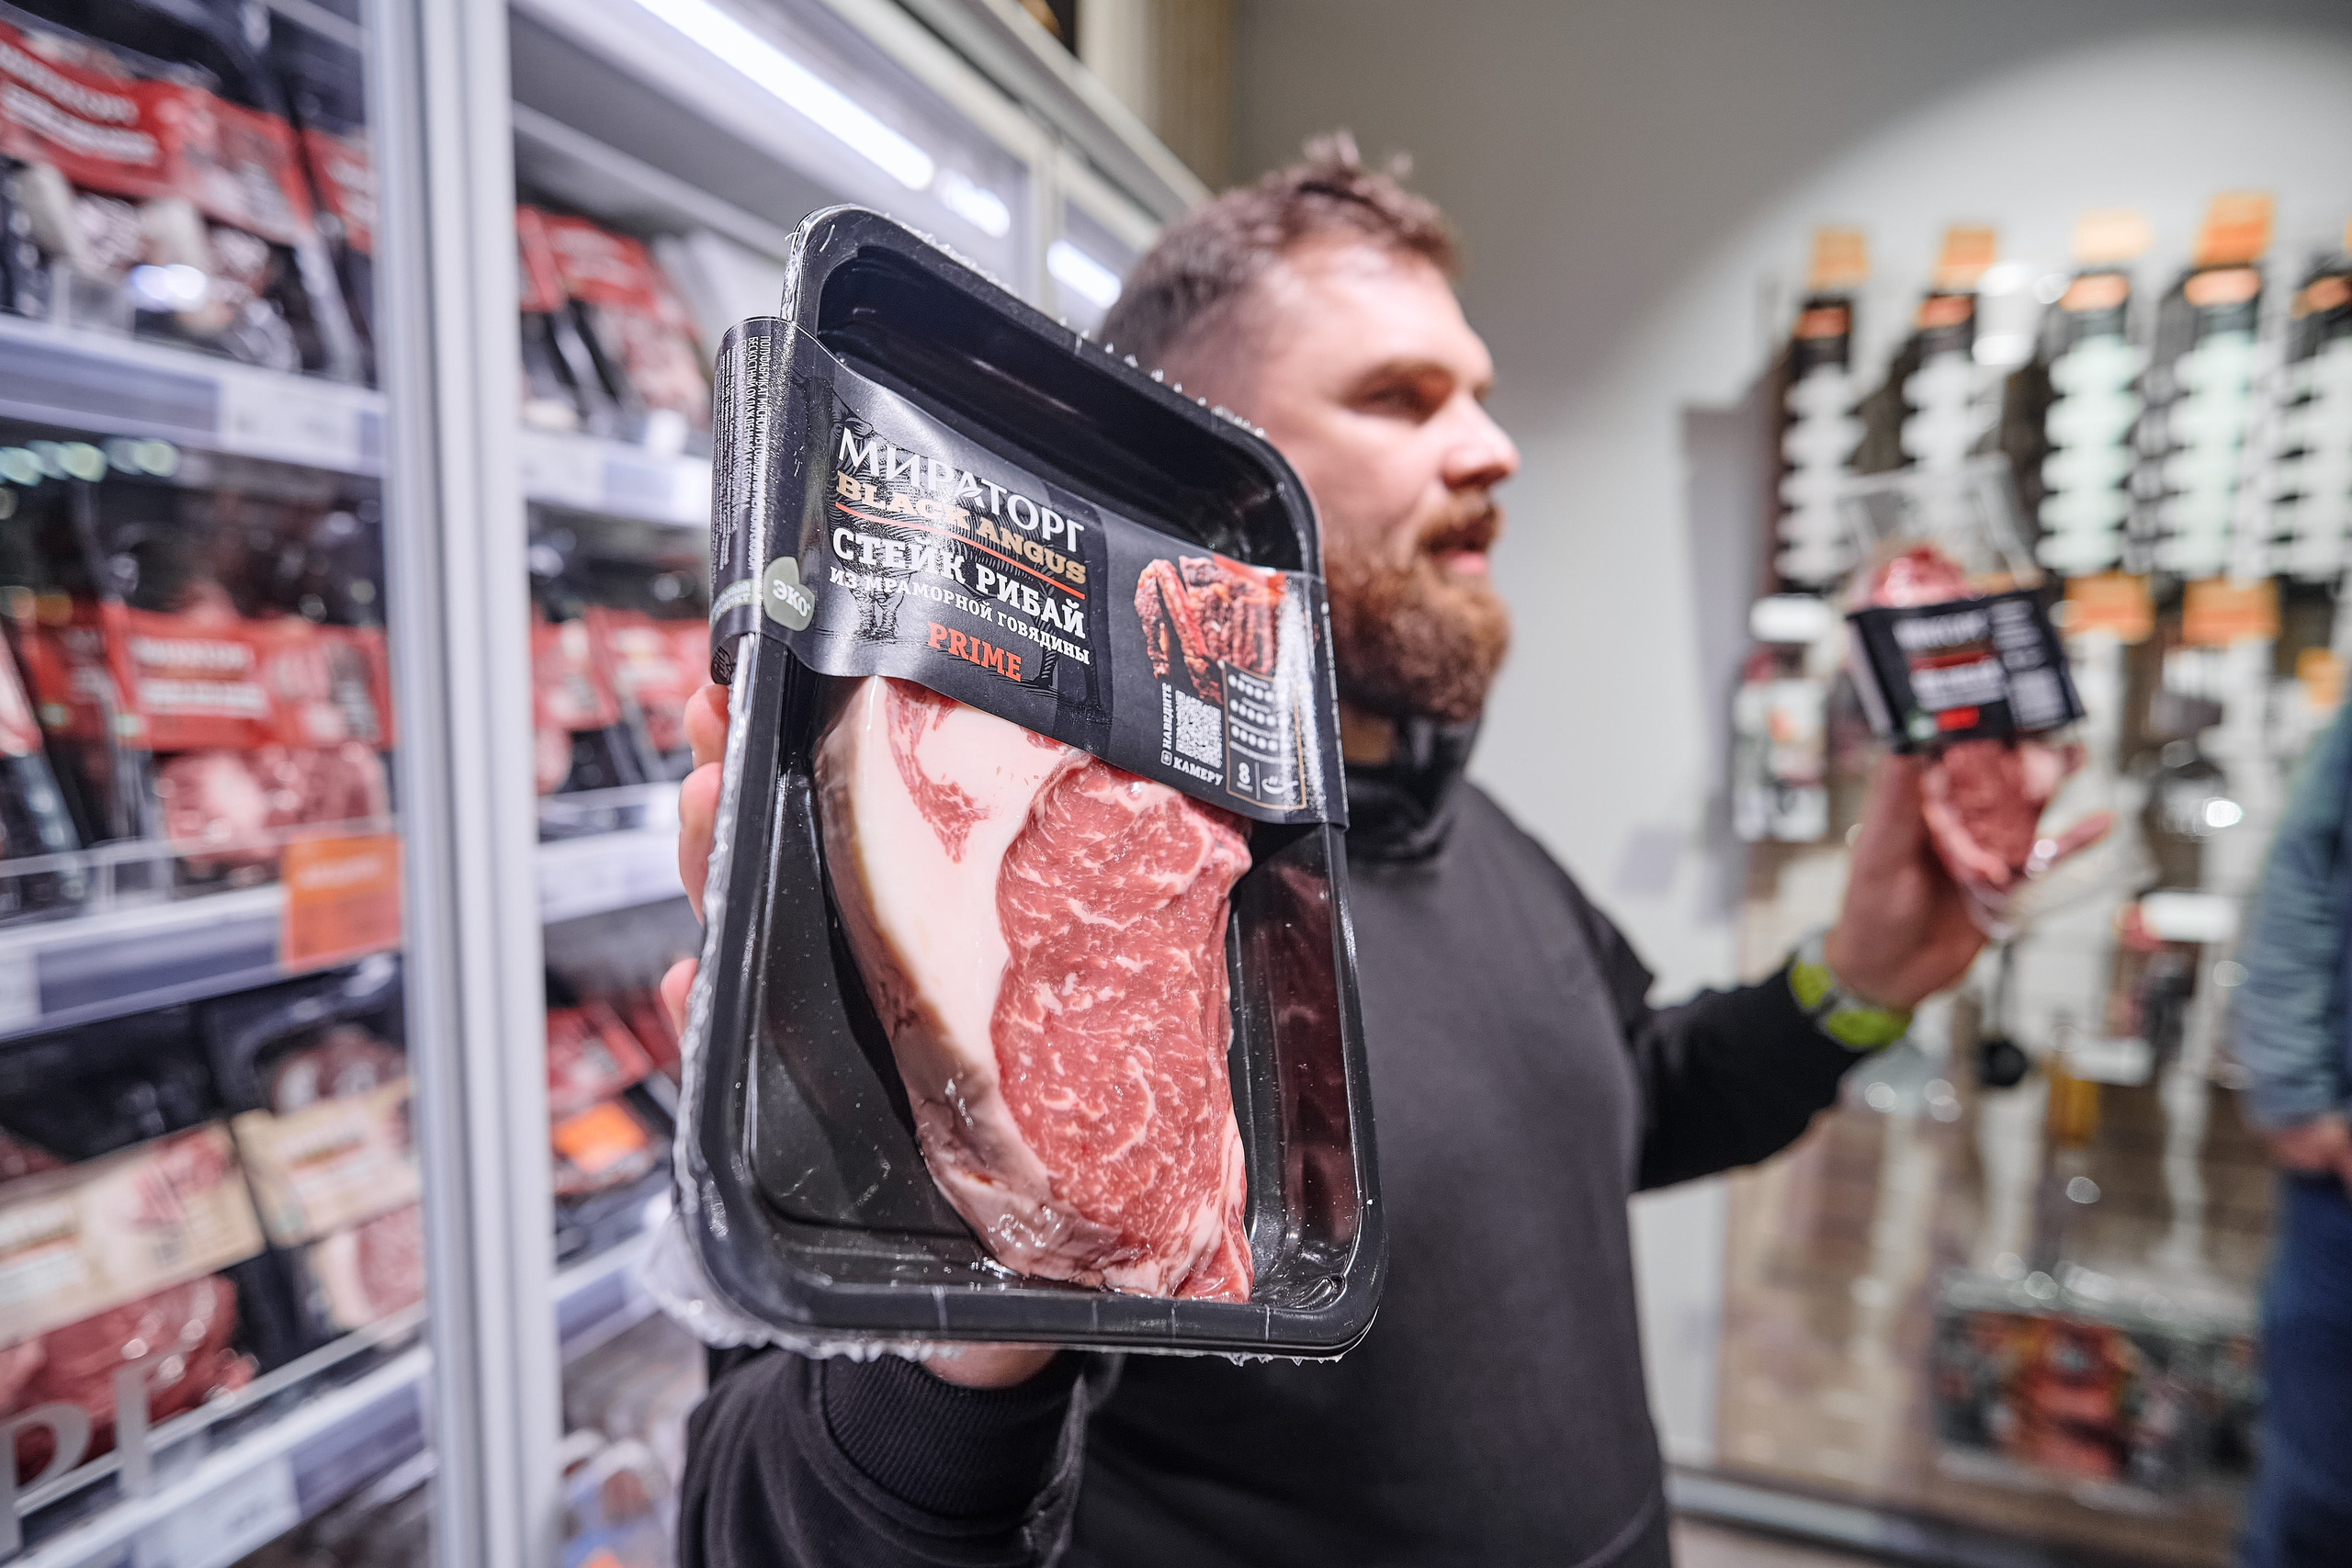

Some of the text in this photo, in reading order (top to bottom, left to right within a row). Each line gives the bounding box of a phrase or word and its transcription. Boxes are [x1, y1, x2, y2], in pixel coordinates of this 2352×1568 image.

[746, 336, 759, 389] БЕСКОСТНЫЙ
[757, 335, 771, 396] ПОЛУФАБРИКАТ
[839, 427, 1085, 552] МИРАТОРГ
[836, 470, 1087, 585] BLACK ANGUS
[832, 527, 1086, 639] СТЕЙК РИБАЙ
[829, 566, 1091, 666] ИЗ МРАМОРНОЙ ГОВЯДИНЫ
[927, 621, 1023, 682] PRIME
[1161, 682, 1174, 750] НАВЕДИТЕ
[1172, 756, 1224, 786] КАМЕРУ
[1238, 761, 1250, 784] 8
